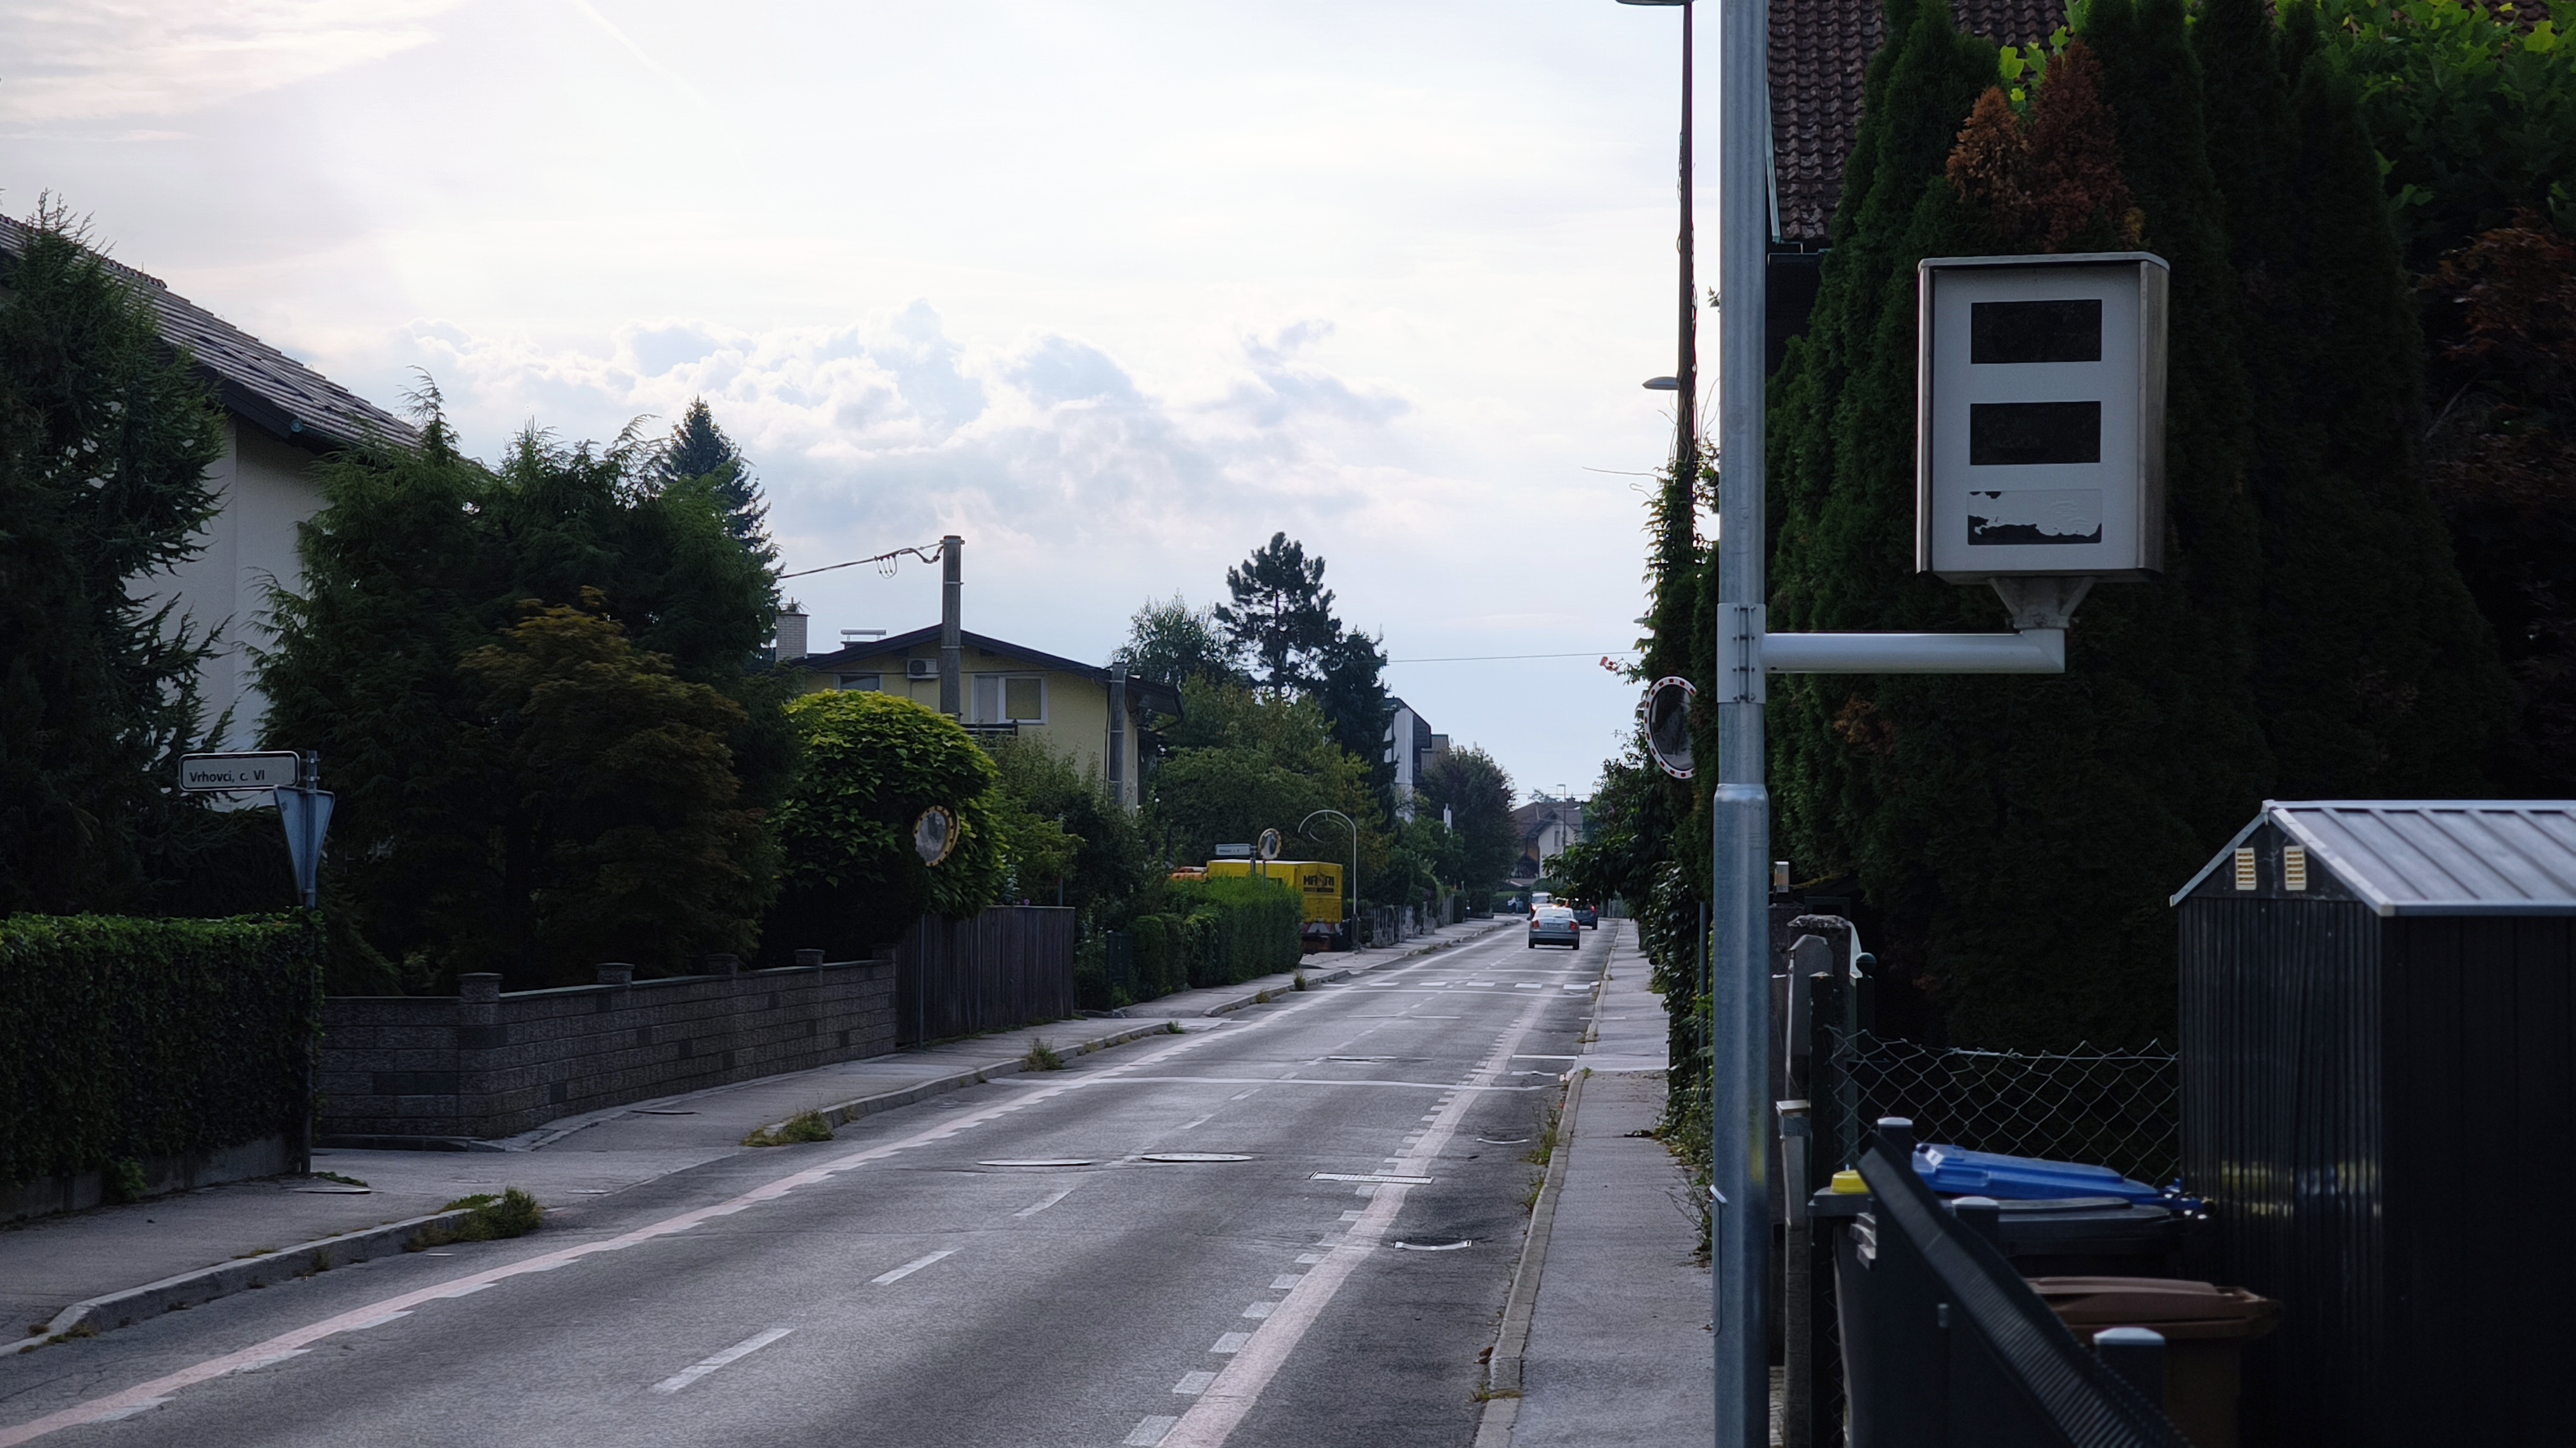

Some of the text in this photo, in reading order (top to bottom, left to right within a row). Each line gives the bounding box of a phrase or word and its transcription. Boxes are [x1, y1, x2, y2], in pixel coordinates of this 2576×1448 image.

[190, 770, 235, 782] Vrhovci,
[254, 770, 265, 780] VI
[1303, 874, 1334, 886] MARI
